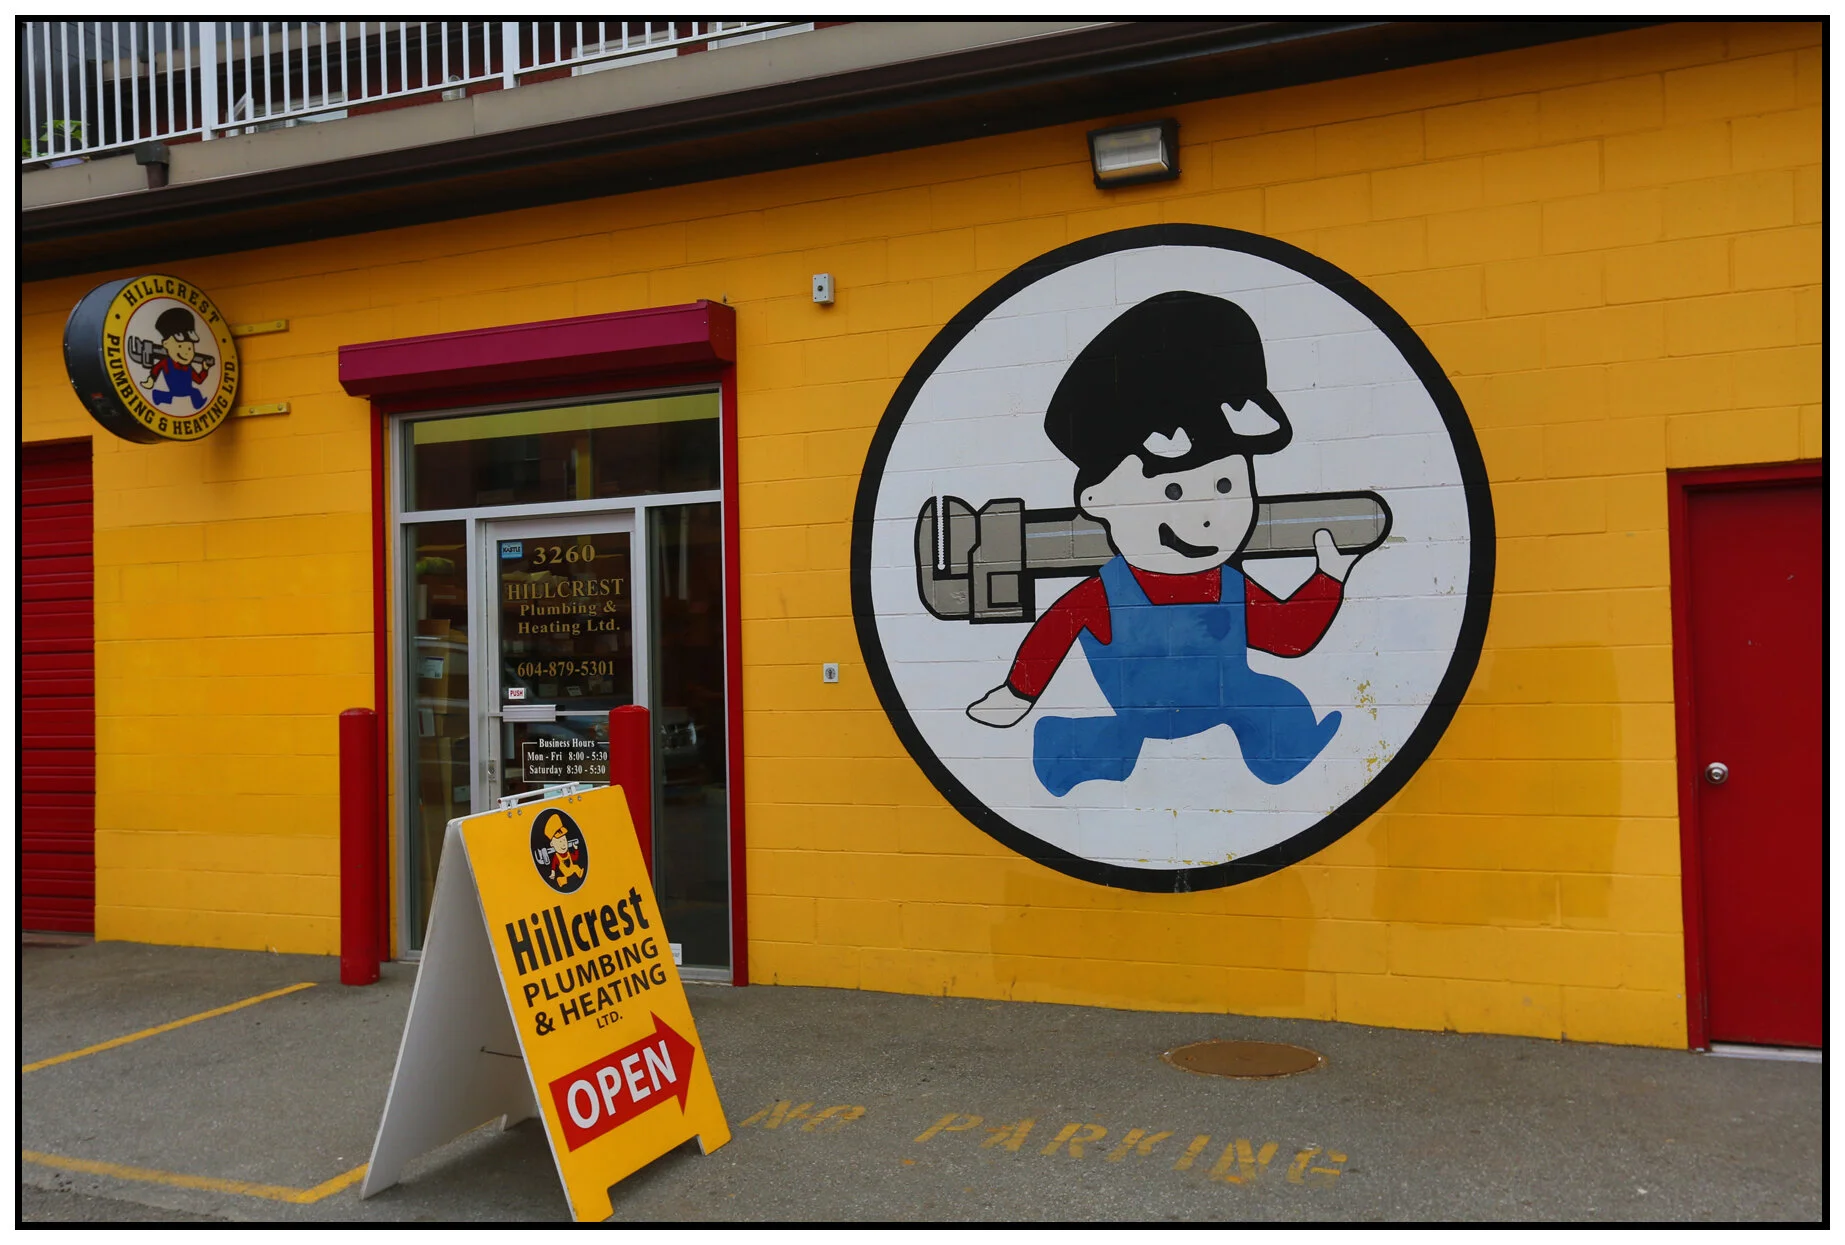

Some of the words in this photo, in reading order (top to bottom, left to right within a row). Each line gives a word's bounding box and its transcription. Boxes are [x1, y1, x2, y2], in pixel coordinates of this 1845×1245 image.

[123, 279, 221, 324] HILLCREST
[106, 333, 154, 424] PLUMBING
[158, 417, 168, 432] &
[173, 395, 228, 435] HEATING
[533, 544, 596, 565] 3260
[508, 578, 624, 600] HILLCREST
[520, 602, 597, 617] Plumbing
[603, 600, 617, 613] &
[518, 621, 581, 636] Heating
[587, 618, 621, 632] Ltd.
[517, 660, 615, 677] 604-879-5301
[510, 688, 524, 697] PUSH
[539, 738, 570, 748] Business
[572, 738, 595, 748] Hours
[527, 751, 544, 761] Mon
[551, 751, 563, 761] Fri
[568, 751, 585, 761] 8:00
[591, 751, 608, 761] 5:30
[529, 765, 563, 776] Saturday
[566, 765, 583, 774] 8:30
[589, 765, 606, 774] 5:30
[505, 886, 649, 976] Hillcrest
[522, 936, 659, 1008] PLUMBING
[535, 1011, 555, 1036] &
[560, 962, 668, 1027] HEATING
[596, 1010, 624, 1029] LTD.
[567, 1039, 678, 1130] OPEN
[739, 1100, 866, 1133] NO
[913, 1111, 1348, 1187] PARKING
